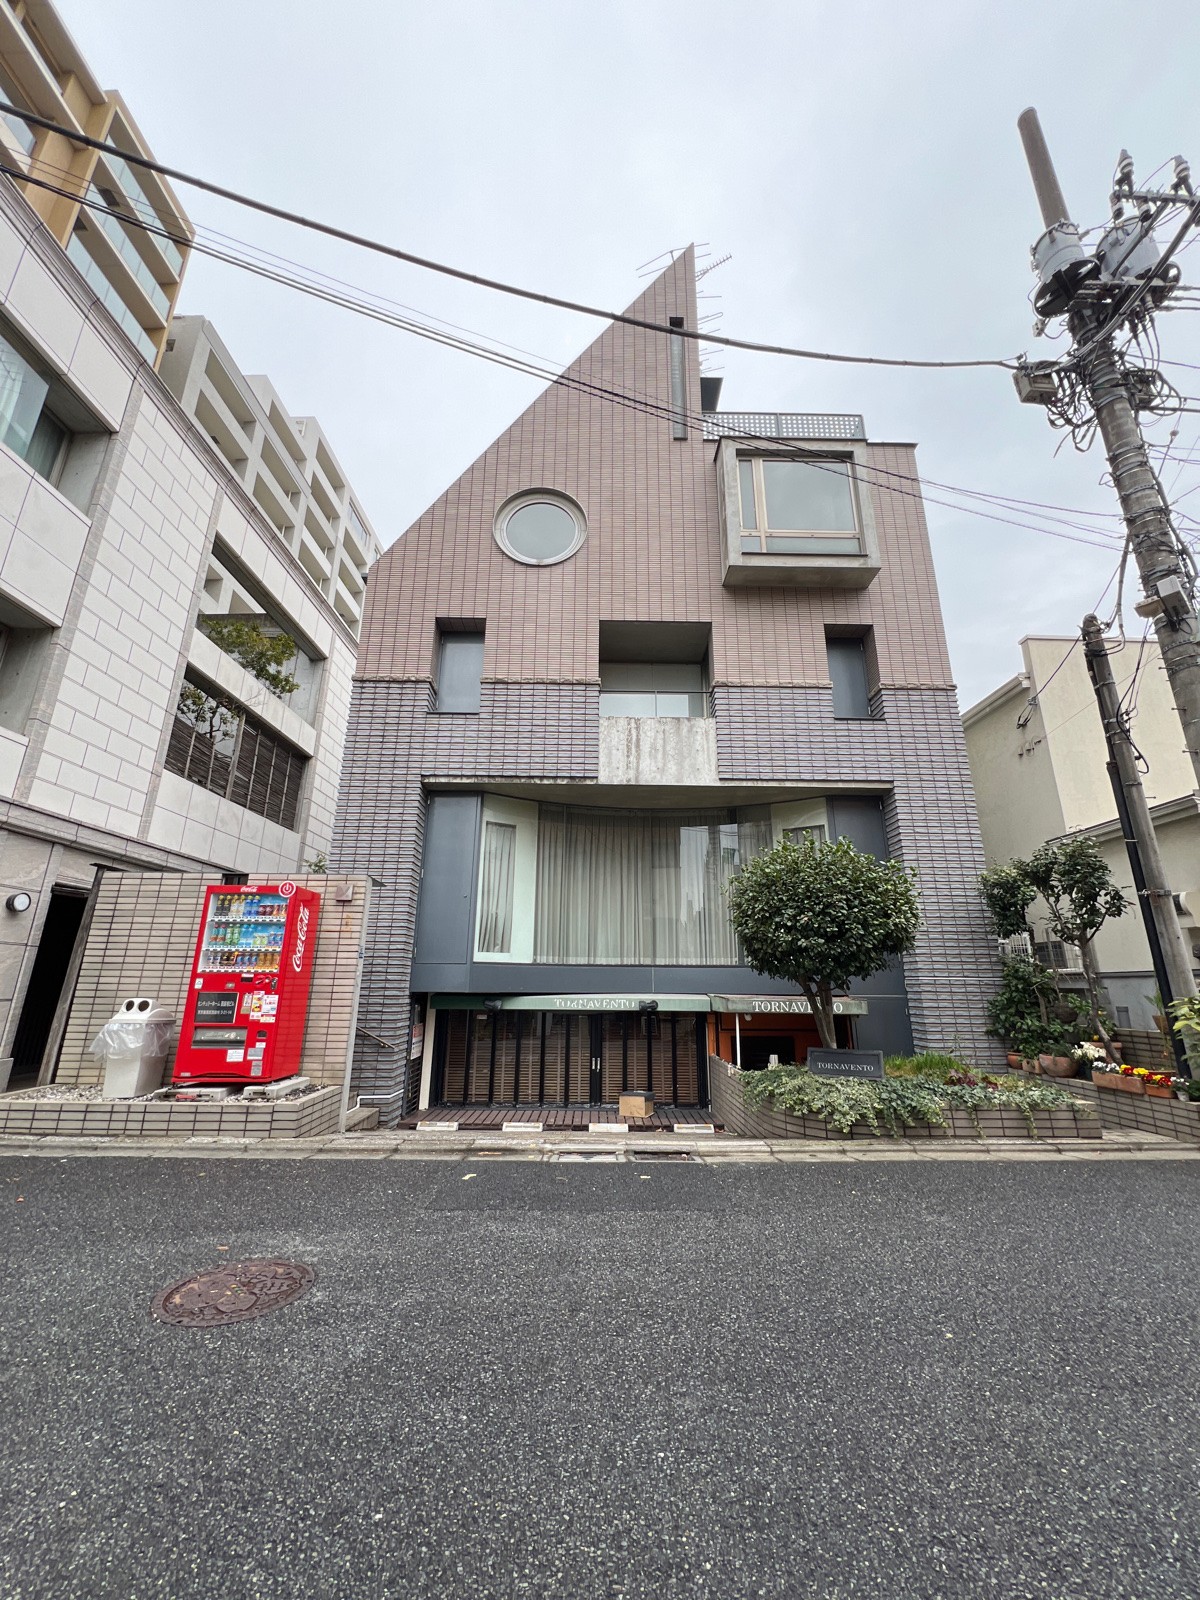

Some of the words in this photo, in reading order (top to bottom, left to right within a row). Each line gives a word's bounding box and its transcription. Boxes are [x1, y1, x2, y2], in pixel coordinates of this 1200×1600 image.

[292, 902, 310, 972] Coca-Cola
[554, 998, 635, 1009] TORNAVENTO
[752, 1001, 844, 1014] TORNAVO
[816, 1062, 874, 1072] TORNAVENTO
